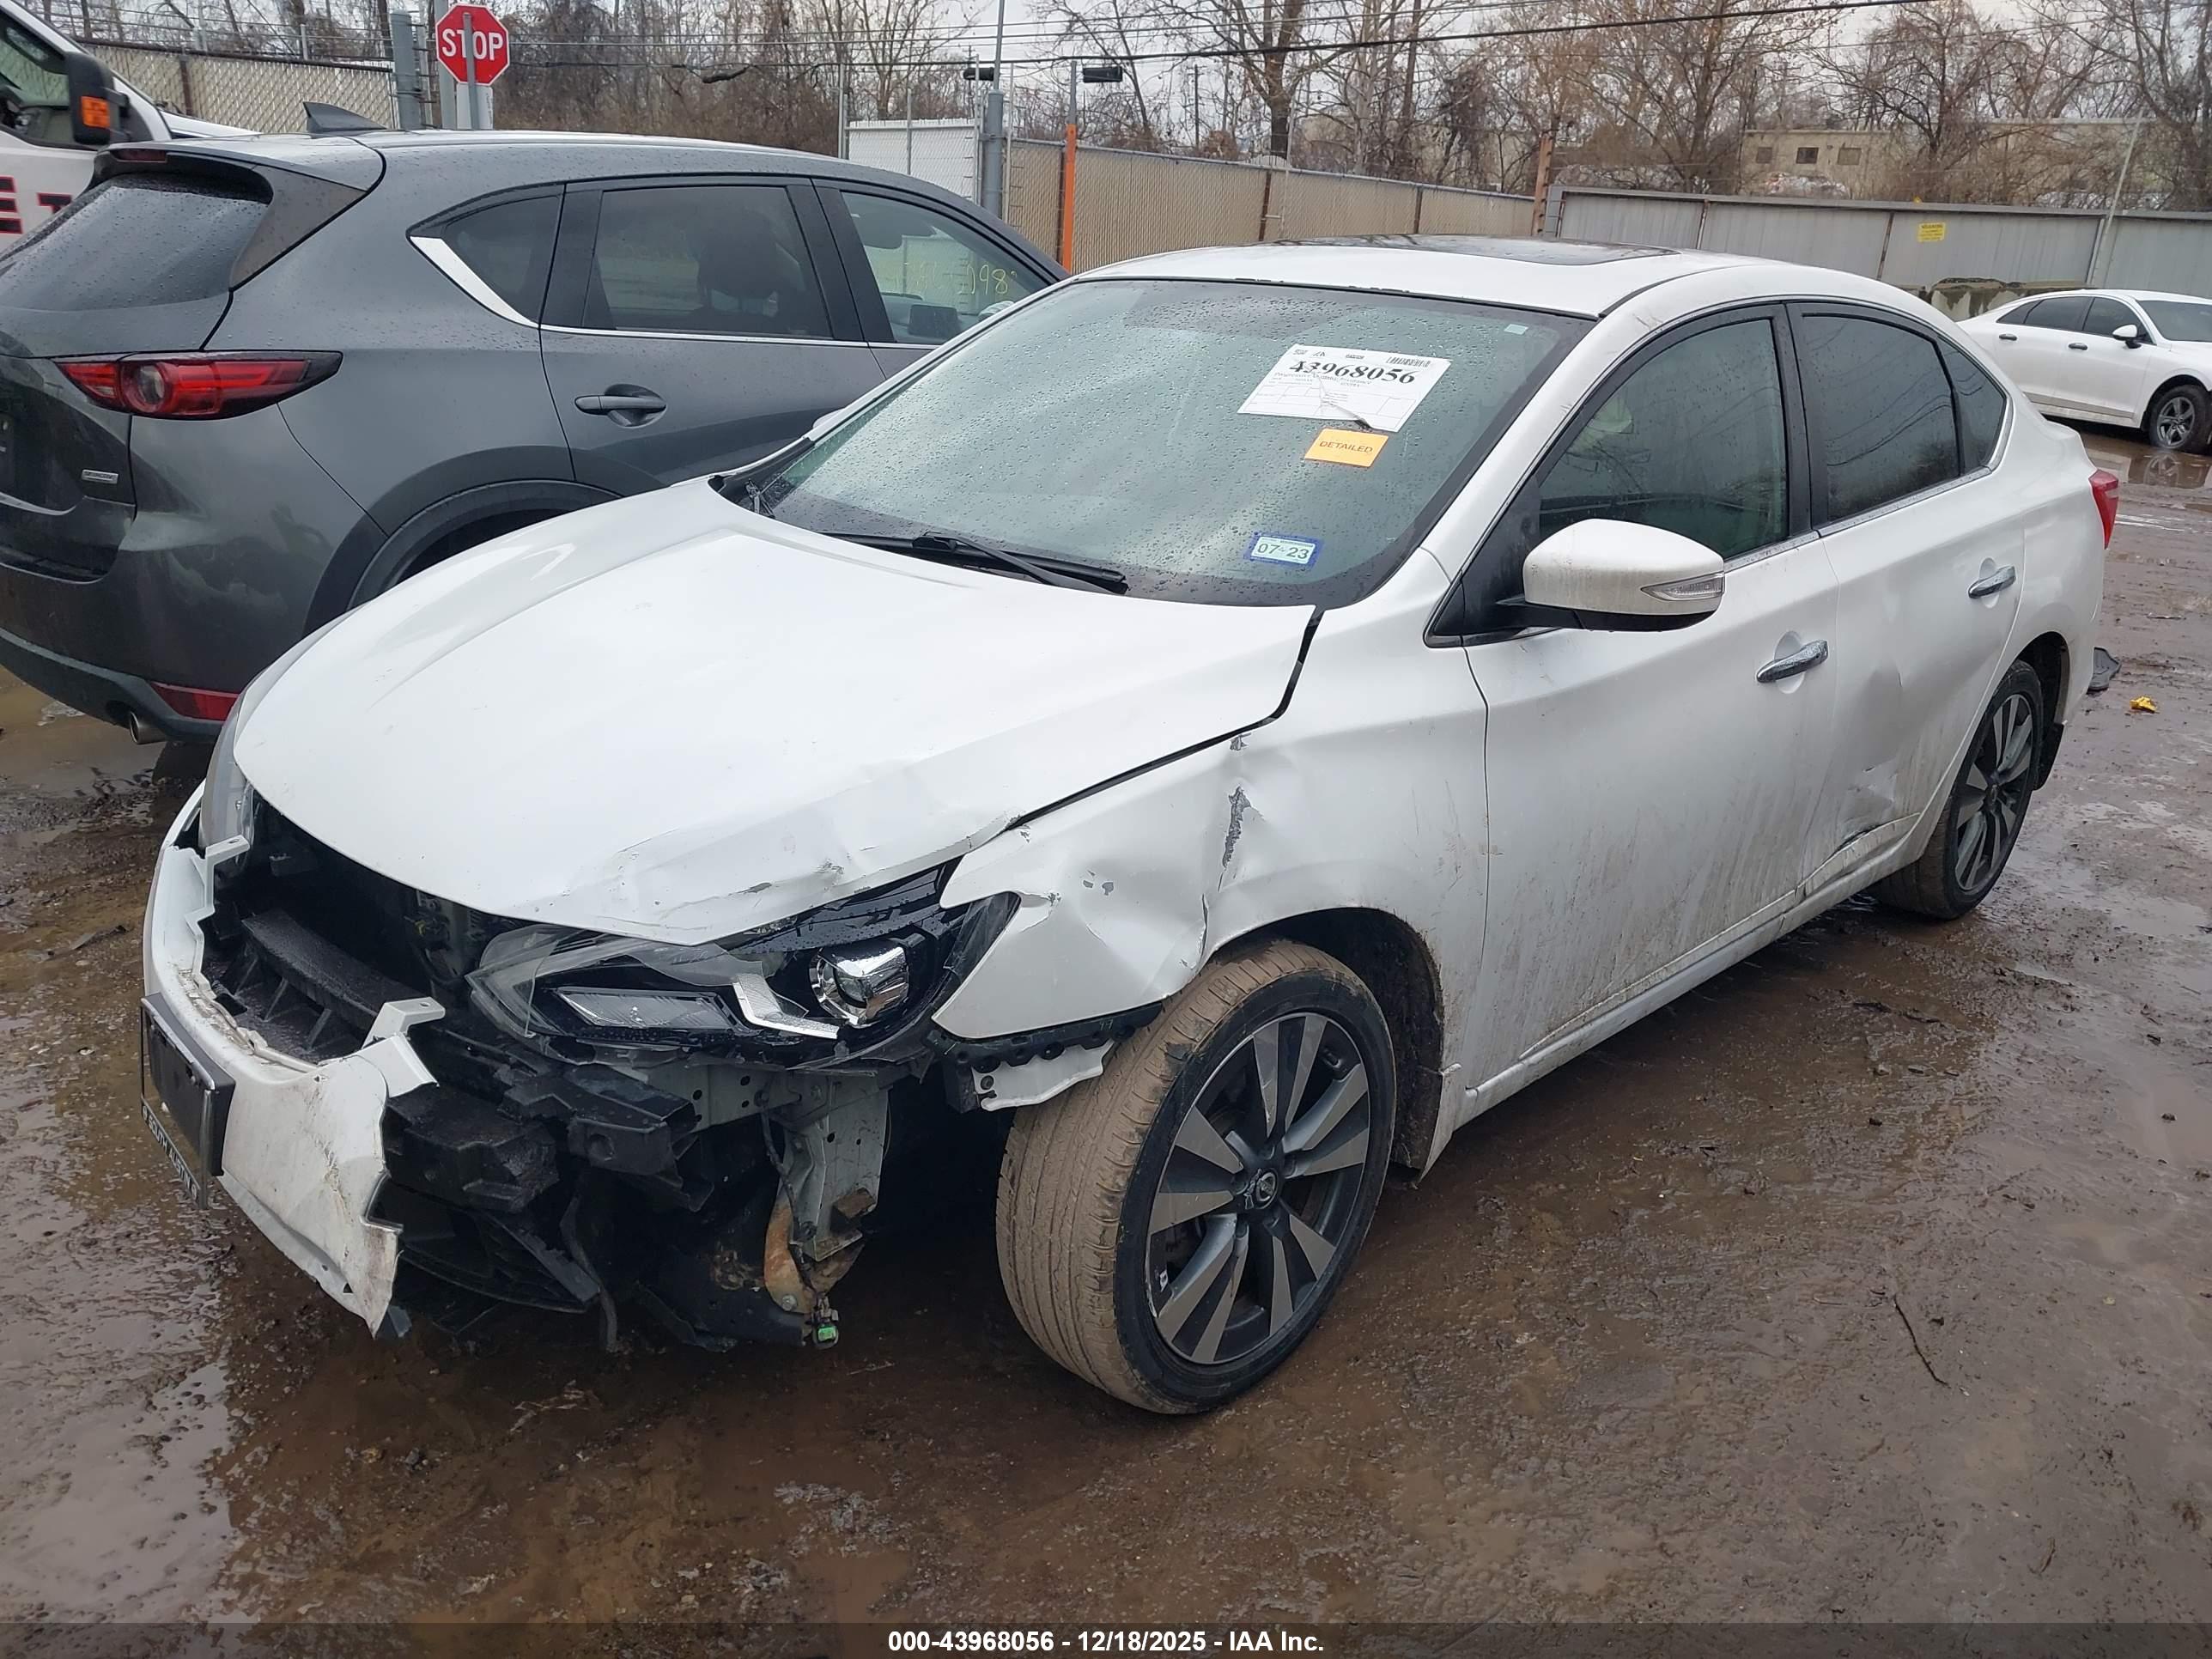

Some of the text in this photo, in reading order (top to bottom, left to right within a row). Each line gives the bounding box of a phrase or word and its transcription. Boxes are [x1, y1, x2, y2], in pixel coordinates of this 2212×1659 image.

[441, 28, 503, 61] STOP
[1289, 360, 1419, 384] 43968056
[1319, 441, 1373, 453] DETAILED
[148, 1115, 191, 1190] SOUTH AUSTIN
